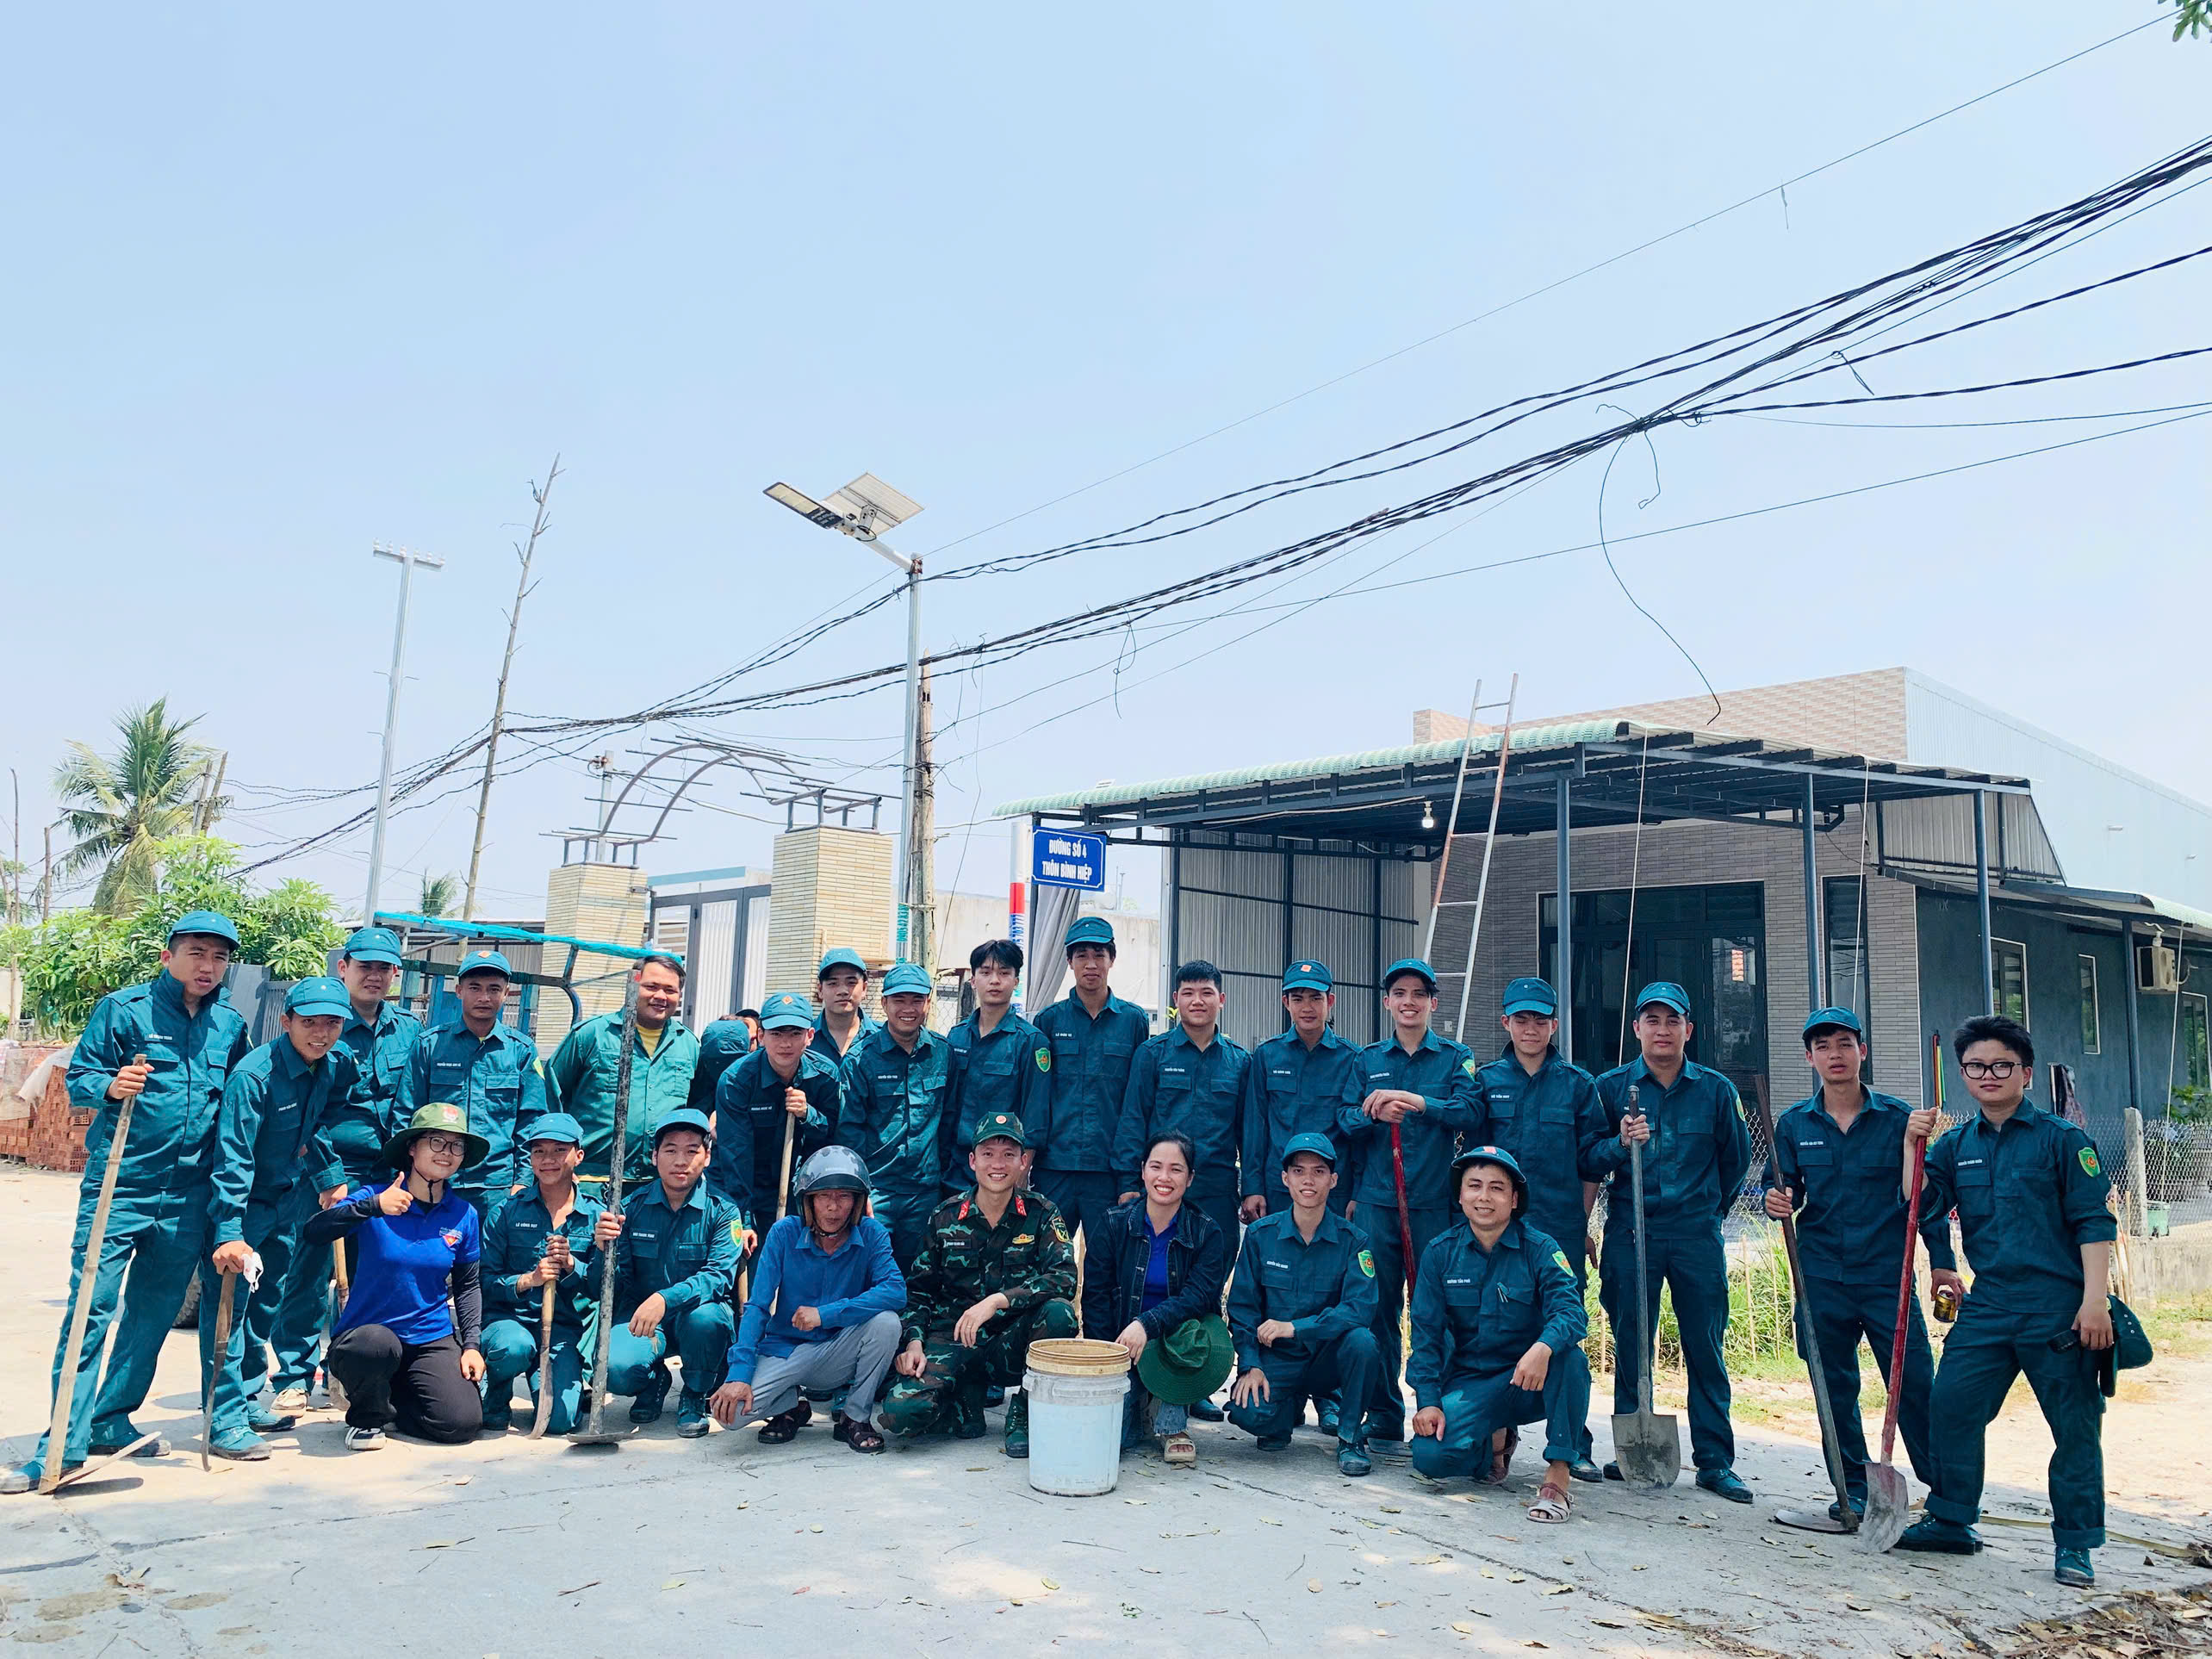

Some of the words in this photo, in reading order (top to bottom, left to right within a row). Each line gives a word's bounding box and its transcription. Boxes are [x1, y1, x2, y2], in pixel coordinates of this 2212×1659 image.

[1048, 837, 1072, 857] ĐƯỜNG
[1072, 838, 1082, 859] SỐ
[1082, 844, 1087, 858] 4
[1042, 859, 1059, 878] THÔN
[1060, 861, 1077, 879] BÌNH
[1077, 863, 1092, 884] HIỆP
